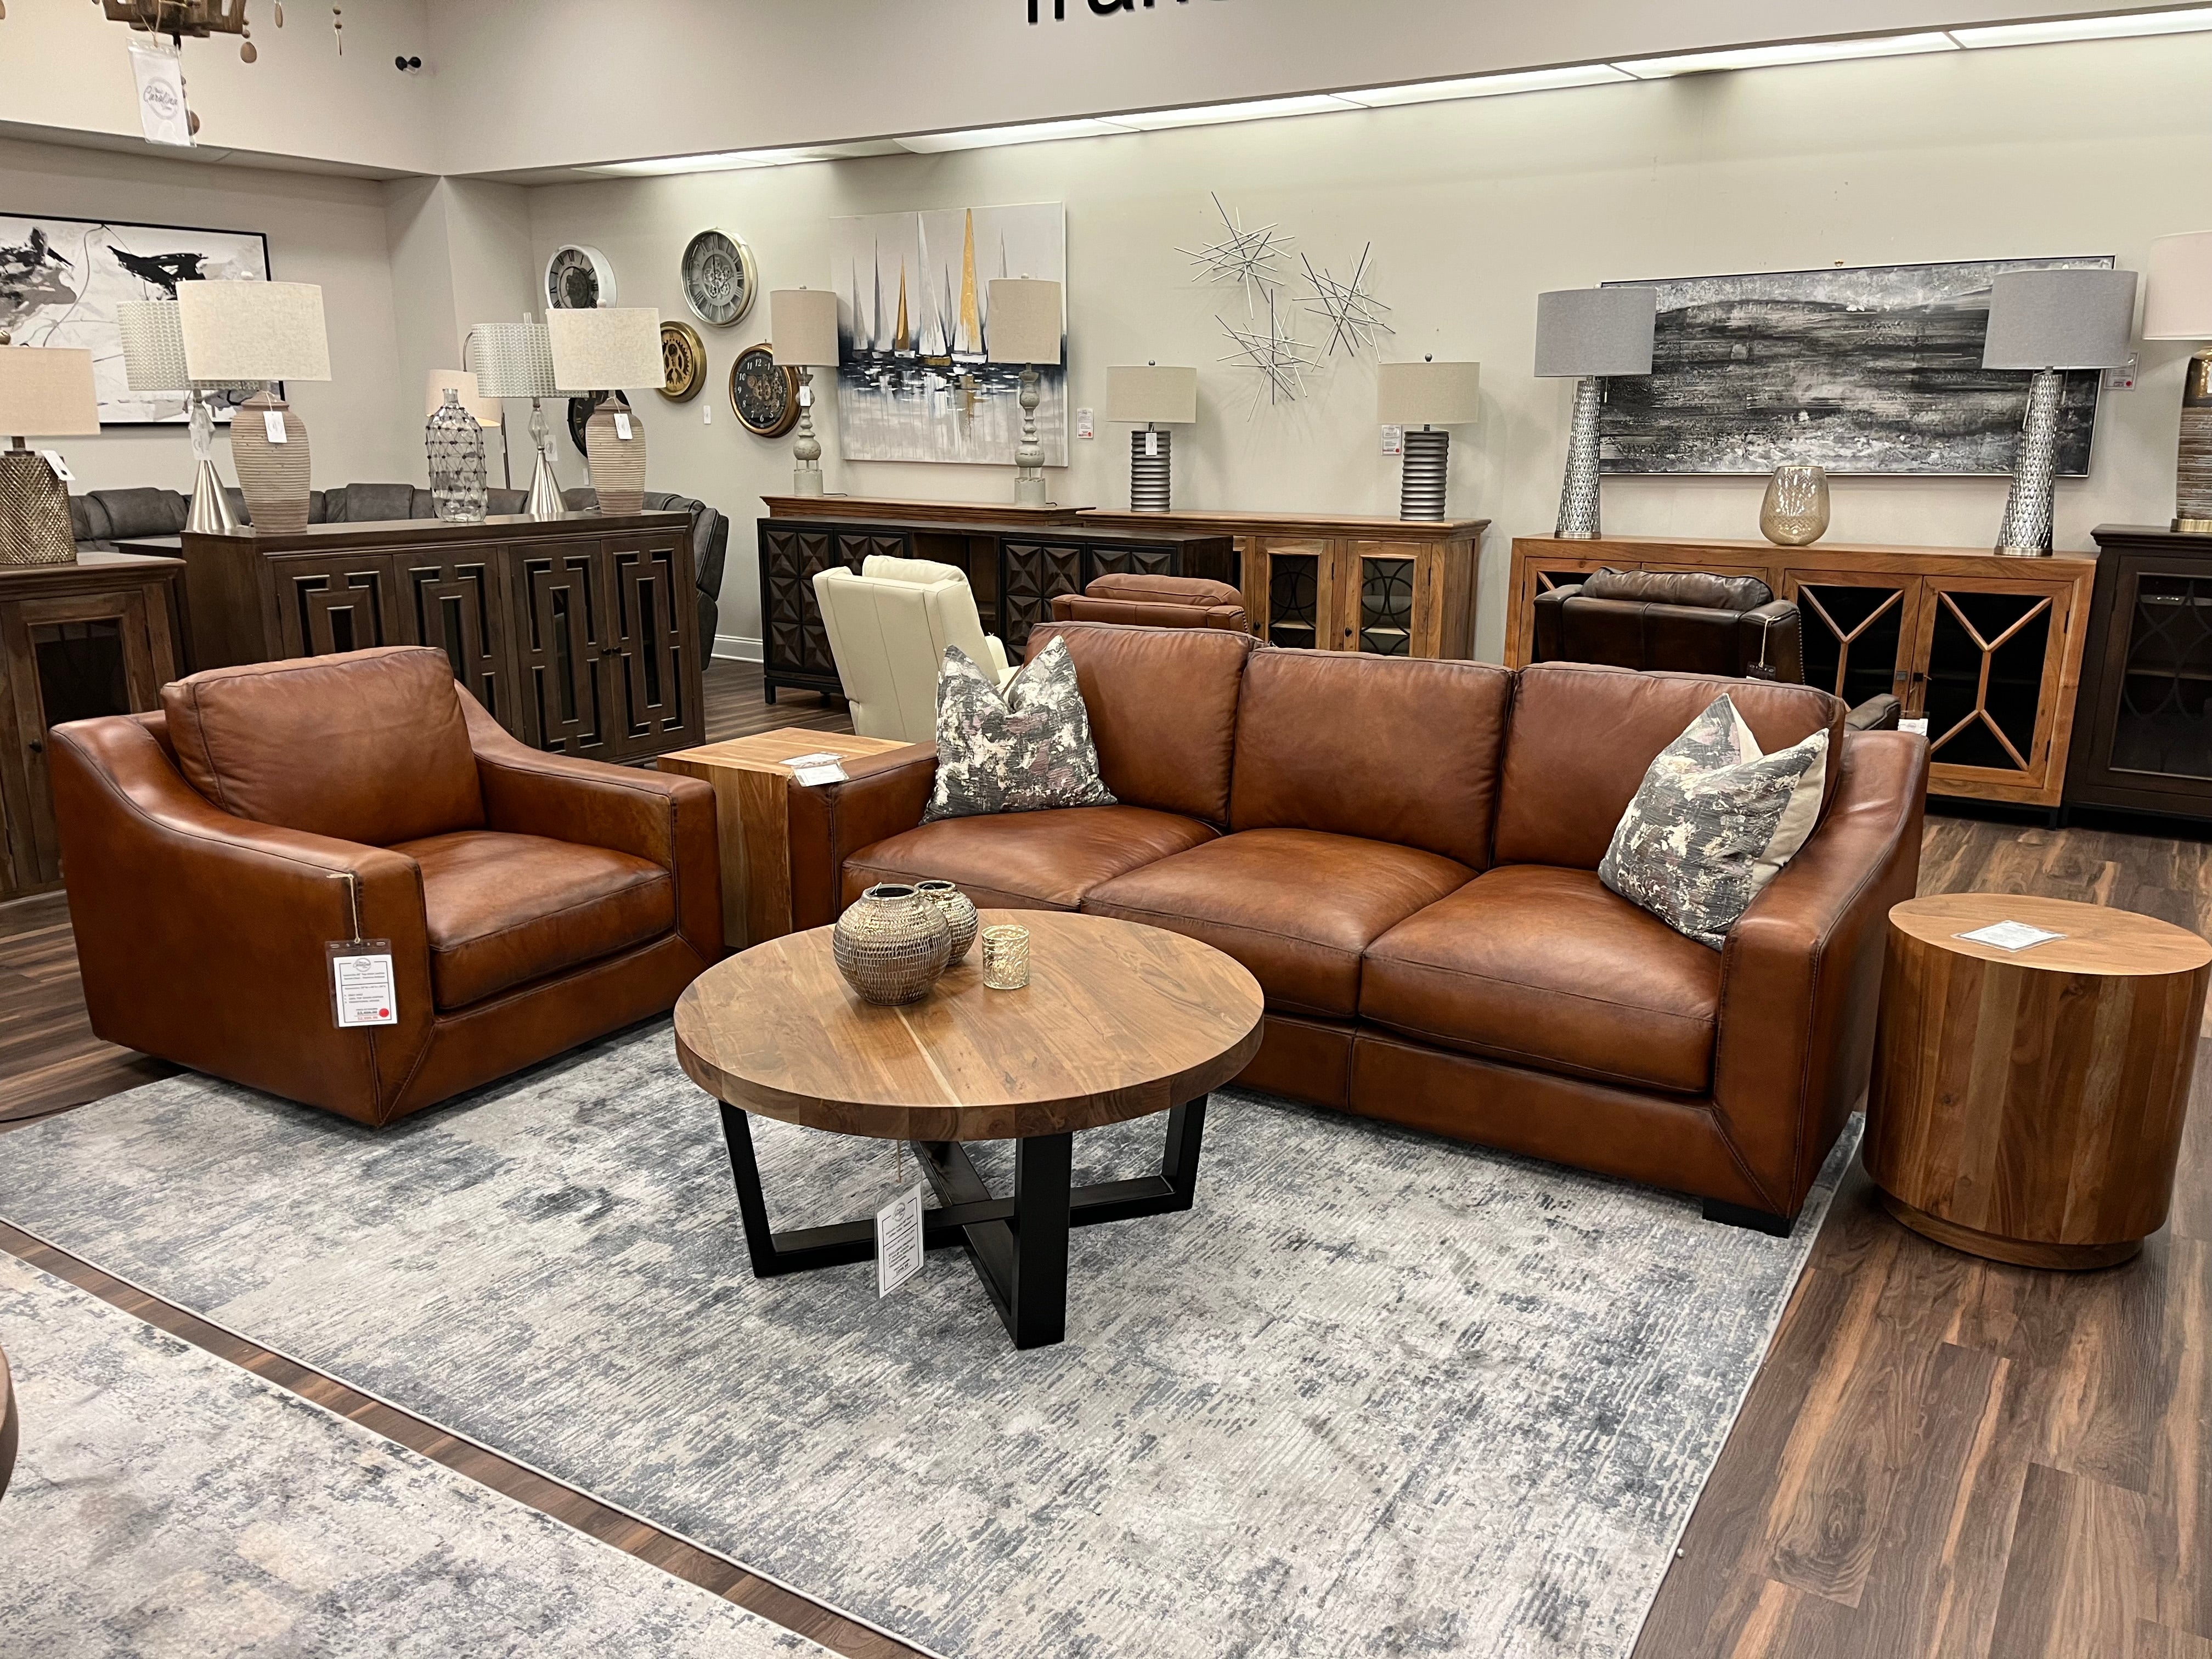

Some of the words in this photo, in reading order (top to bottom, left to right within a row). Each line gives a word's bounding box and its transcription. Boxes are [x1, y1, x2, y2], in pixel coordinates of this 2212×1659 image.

[143, 86, 178, 105] Carolina
[747, 362, 753, 370] 11
[755, 358, 762, 367] 12
[739, 373, 746, 381] 10
[778, 386, 783, 394] 3
[742, 399, 747, 408] 8
[751, 410, 754, 419] 7
[759, 414, 764, 422] 6
[769, 410, 774, 419] 5
